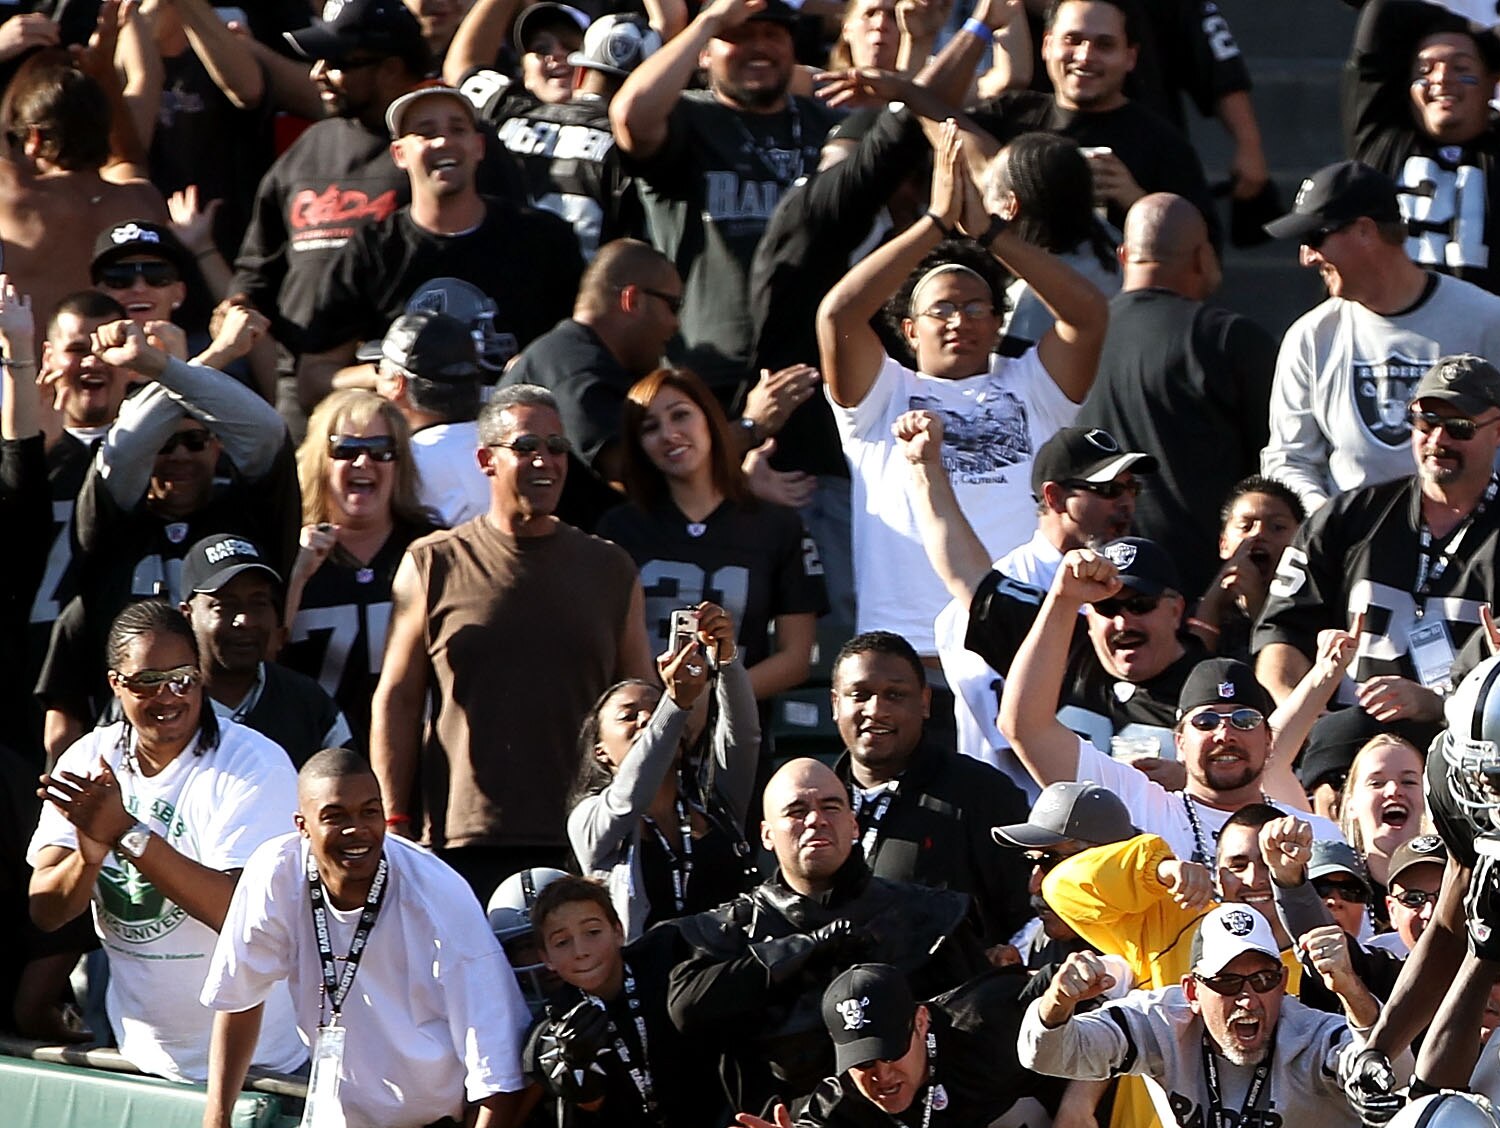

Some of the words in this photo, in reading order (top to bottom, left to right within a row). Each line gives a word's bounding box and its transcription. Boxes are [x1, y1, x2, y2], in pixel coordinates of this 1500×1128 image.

[1269, 545, 1309, 598] 5
[367, 859, 388, 904] RAIDERS
[314, 907, 331, 953] RAIDERS
